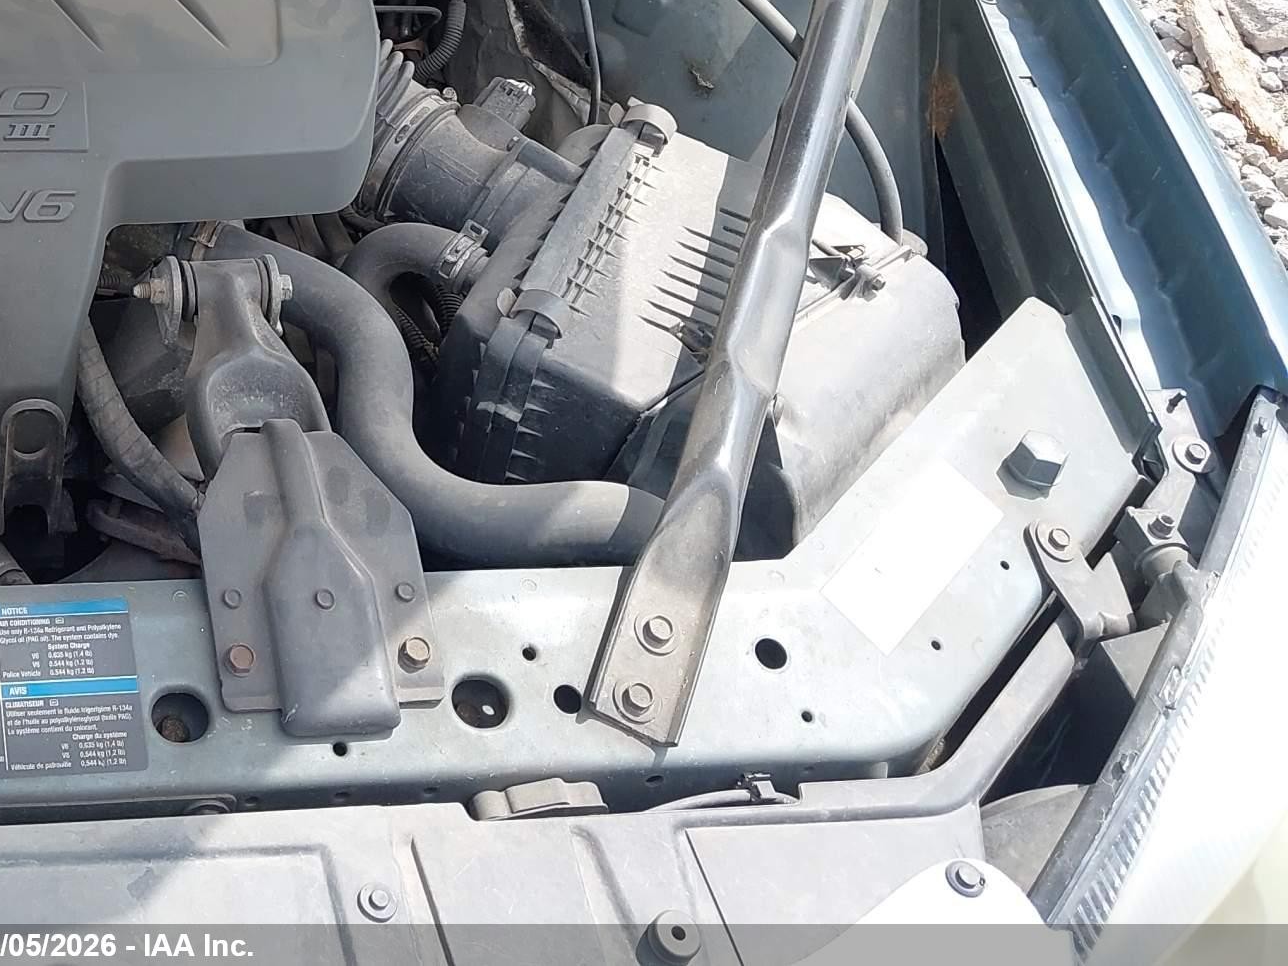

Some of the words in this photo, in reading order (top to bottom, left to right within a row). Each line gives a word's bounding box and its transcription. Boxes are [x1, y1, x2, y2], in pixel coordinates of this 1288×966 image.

[3, 123, 55, 141] III
[1, 607, 28, 615] NOTICE
[9, 687, 27, 695] AVIS
